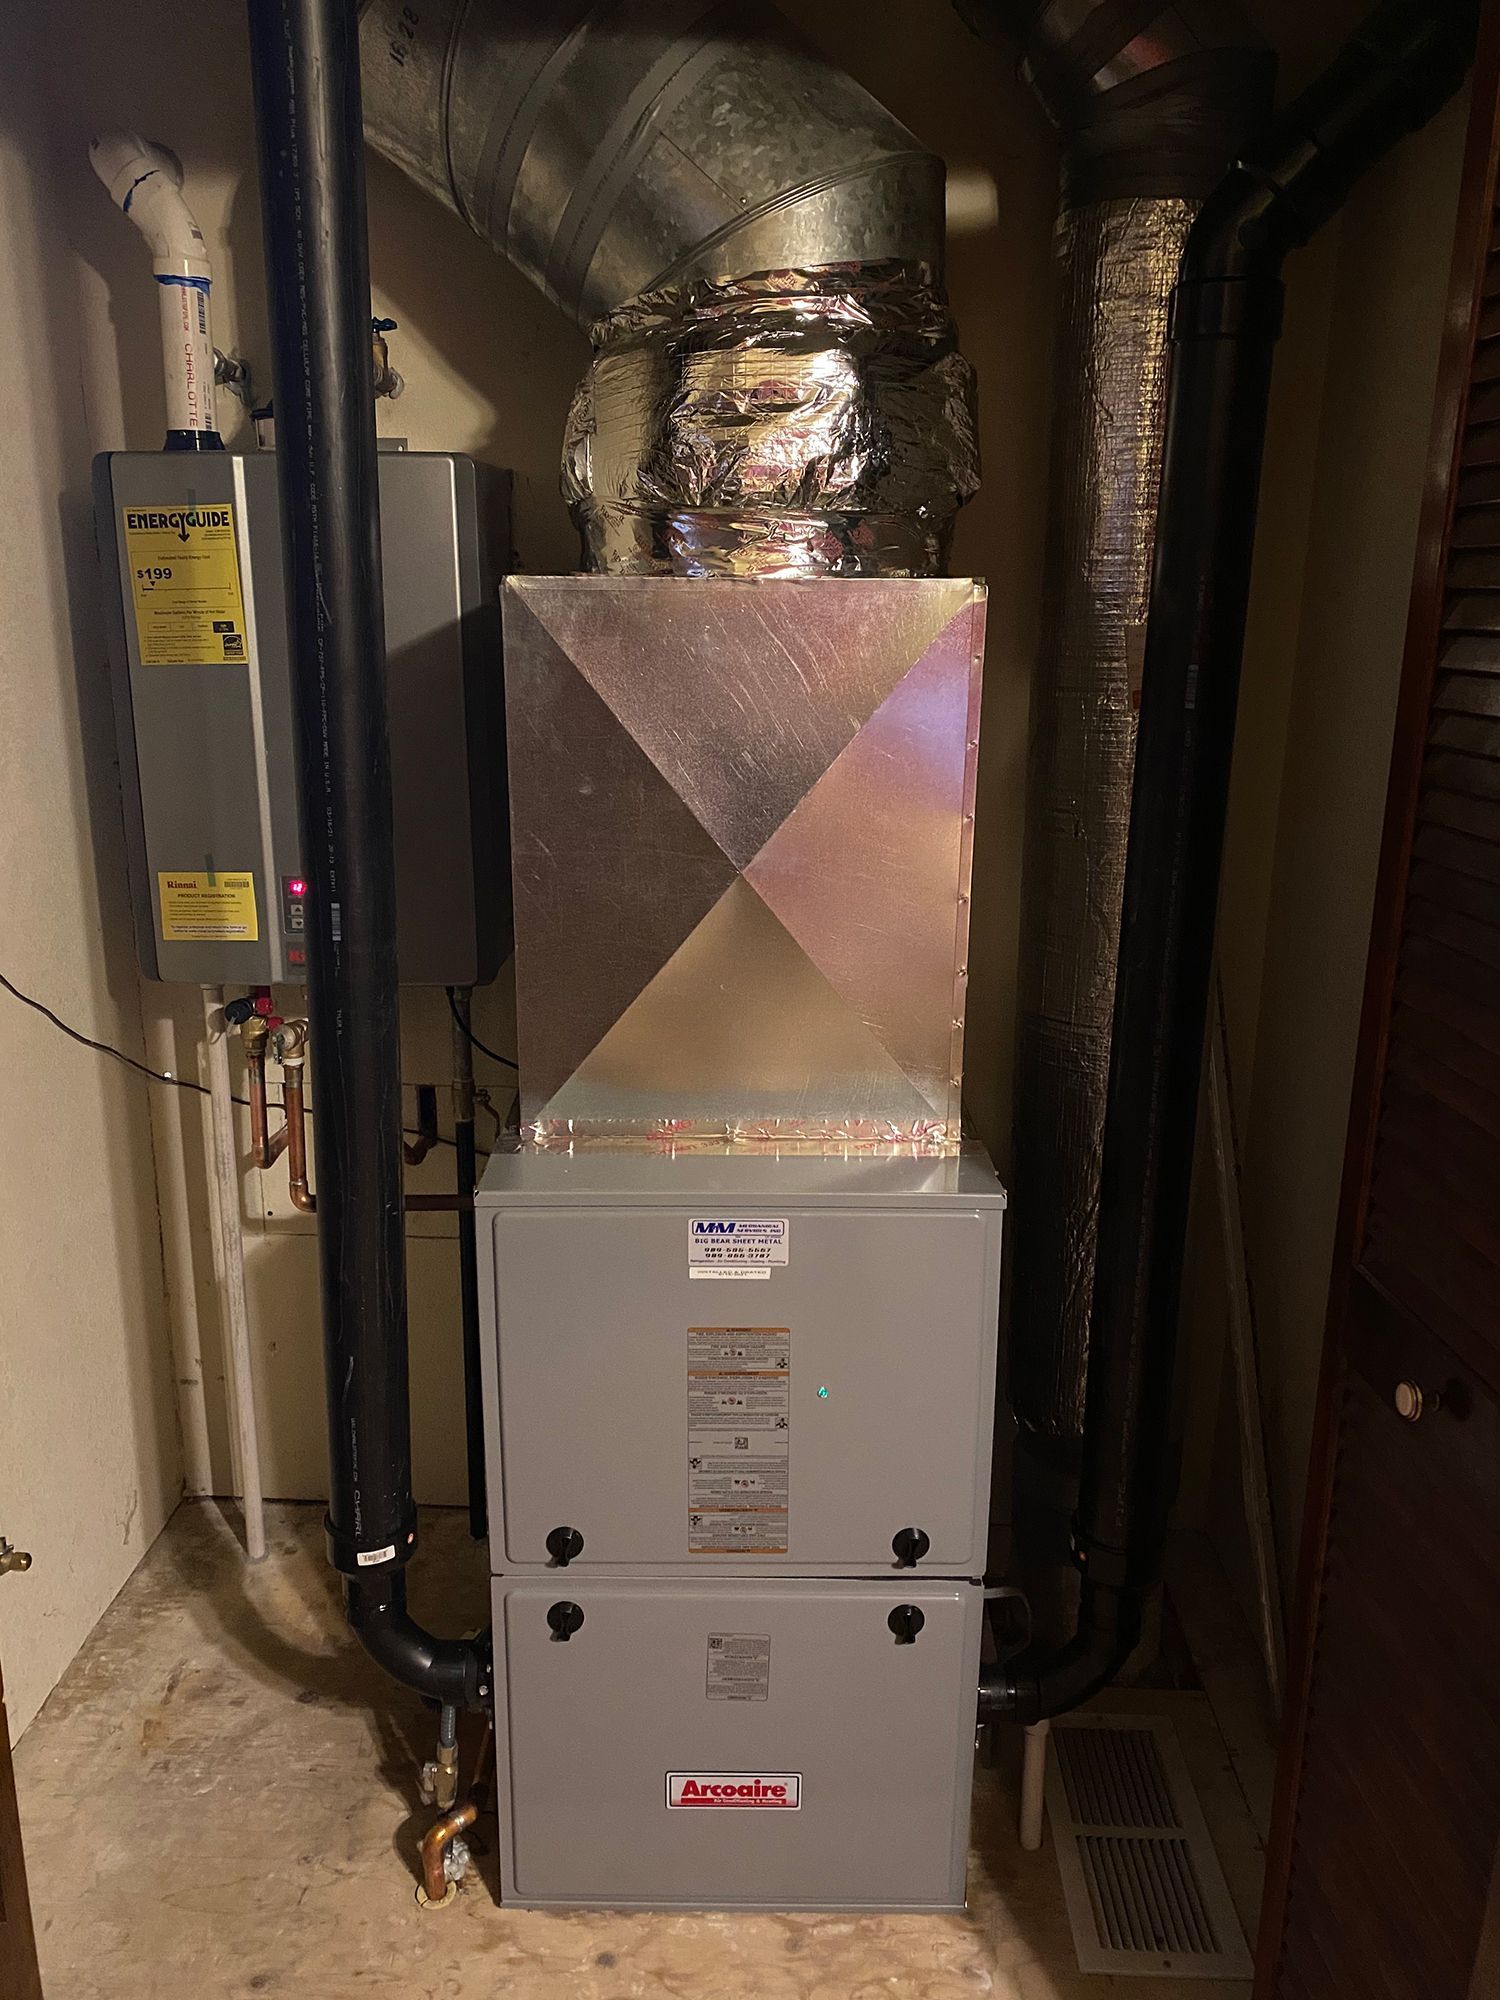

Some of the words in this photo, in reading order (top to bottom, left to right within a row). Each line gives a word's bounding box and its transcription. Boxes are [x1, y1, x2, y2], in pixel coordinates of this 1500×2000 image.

[184, 342, 197, 427] CHARLOTTE
[127, 511, 230, 530] ENERGYGUIDE
[136, 567, 172, 580] $199
[167, 880, 197, 889] Rinnai
[681, 1779, 787, 1798] Arcoaire
